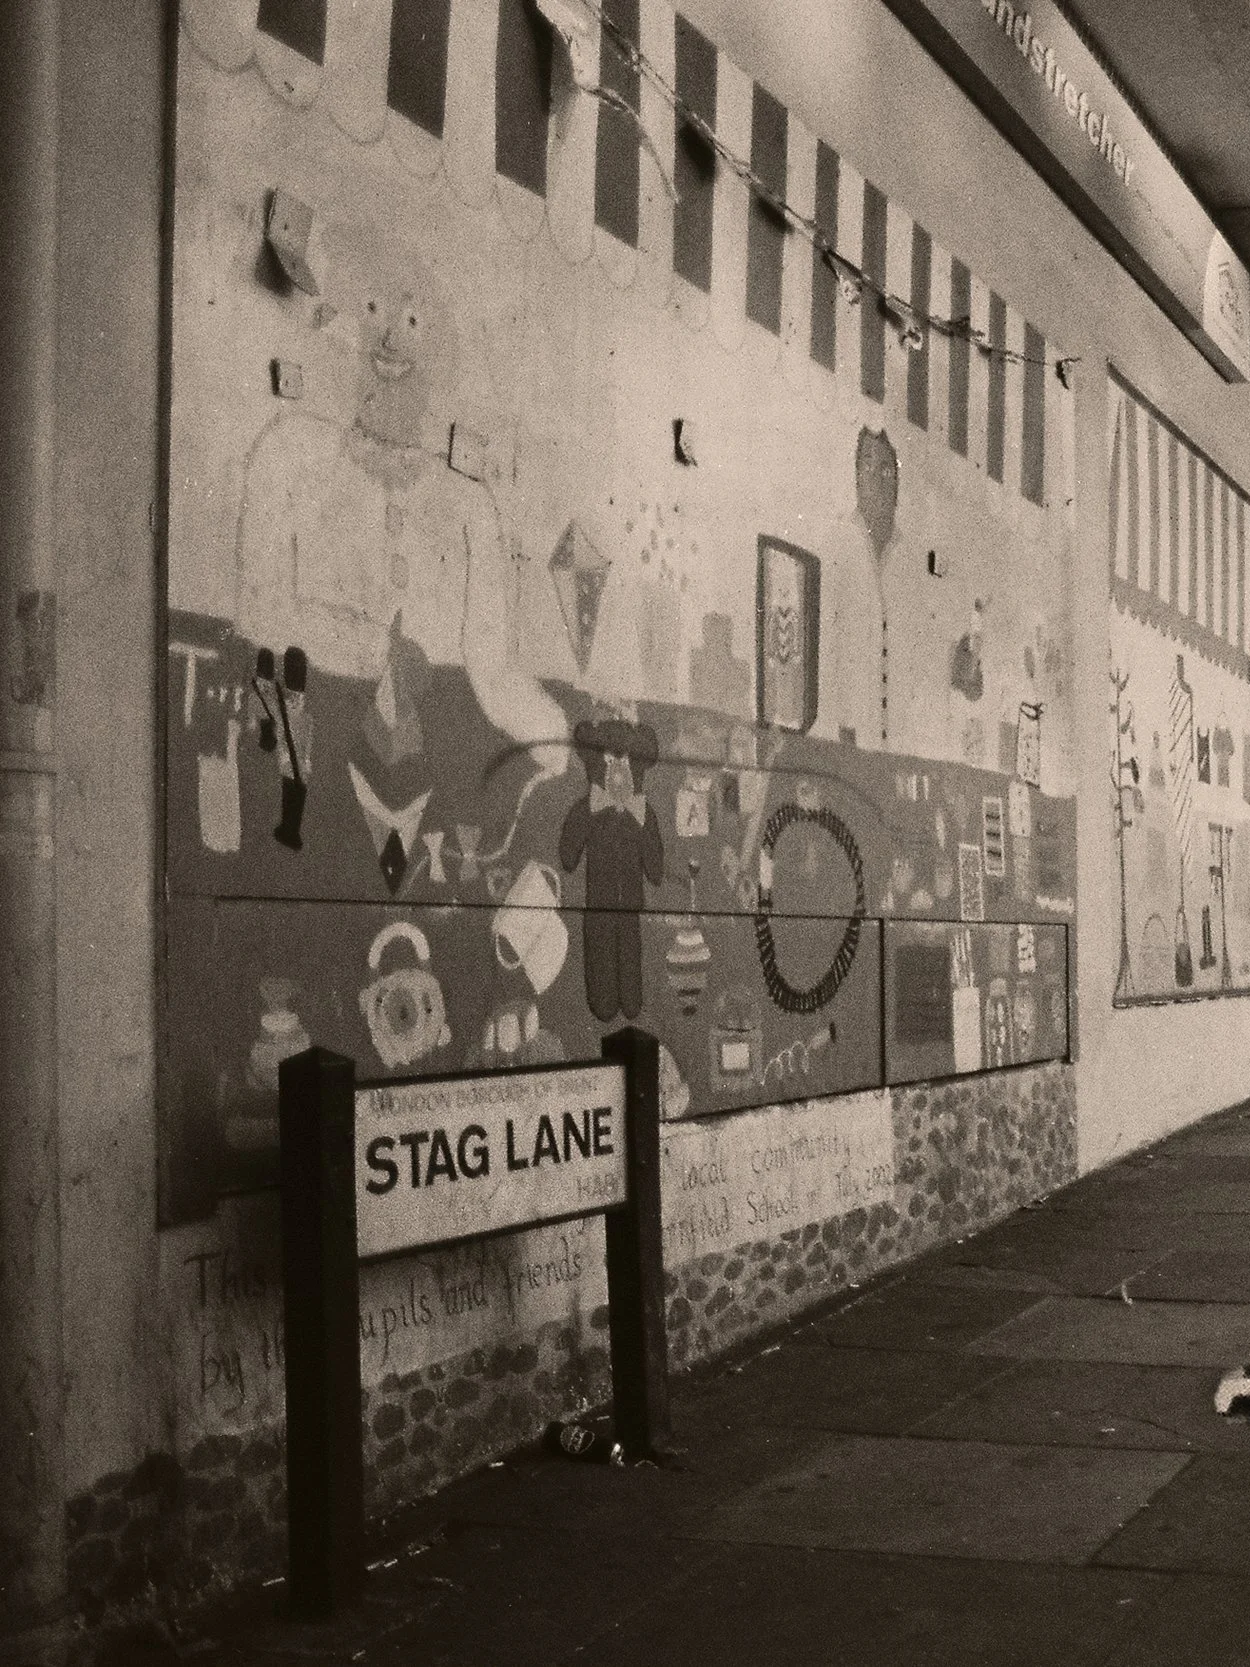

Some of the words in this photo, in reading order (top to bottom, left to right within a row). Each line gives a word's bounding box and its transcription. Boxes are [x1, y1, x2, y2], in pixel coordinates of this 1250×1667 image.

[980, 0, 1134, 188] ndstretcher
[365, 1124, 490, 1196] STAG
[506, 1106, 614, 1172] LANE
[201, 1329, 247, 1416] by
[359, 1276, 432, 1367] upils
[502, 1235, 583, 1324] friends
